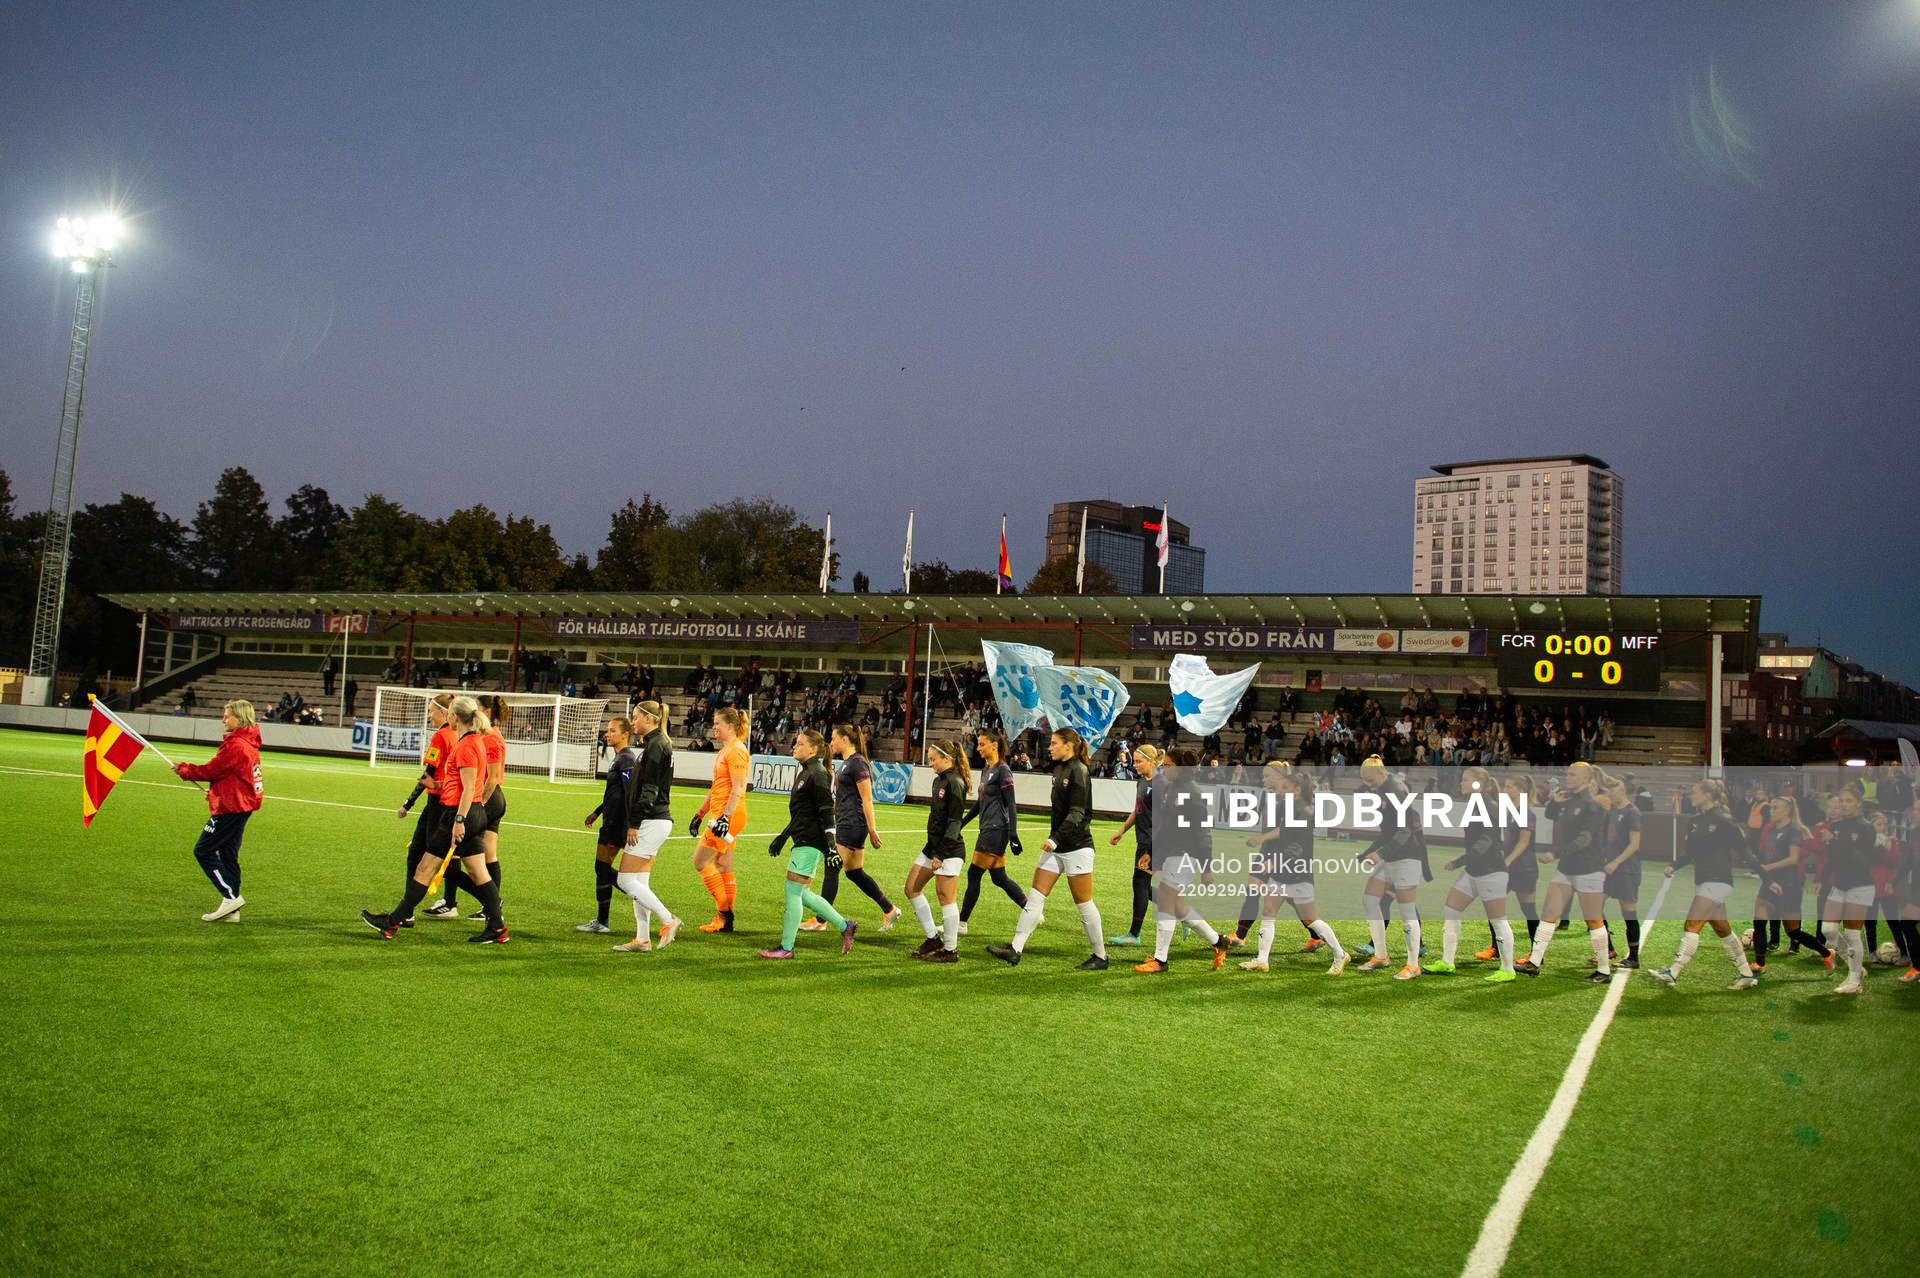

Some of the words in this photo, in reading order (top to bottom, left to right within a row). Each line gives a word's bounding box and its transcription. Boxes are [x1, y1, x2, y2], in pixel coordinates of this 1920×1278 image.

[180, 616, 222, 627] HATTRICK
[224, 617, 236, 628] BY
[239, 617, 251, 628] FC
[251, 615, 311, 629] ROSENGÅRD
[558, 618, 584, 634] FÖR
[587, 619, 646, 635] HÅLLBAR
[650, 623, 742, 637] TJEJFOTBOLL
[746, 624, 750, 637] I
[755, 621, 806, 639] SKÅNE
[1153, 631, 1198, 646] MED
[1203, 627, 1259, 647] STÖD
[1266, 628, 1324, 649] FRÅN
[1338, 632, 1375, 641] Sparbanken
[1406, 637, 1450, 646] Swedbank
[1501, 634, 1536, 647] FCR
[1545, 634, 1612, 655] 0:00
[1621, 636, 1659, 649] MFF
[1534, 660, 1555, 682] 0
[1601, 661, 1622, 685] 0
[352, 725, 371, 745] DI
